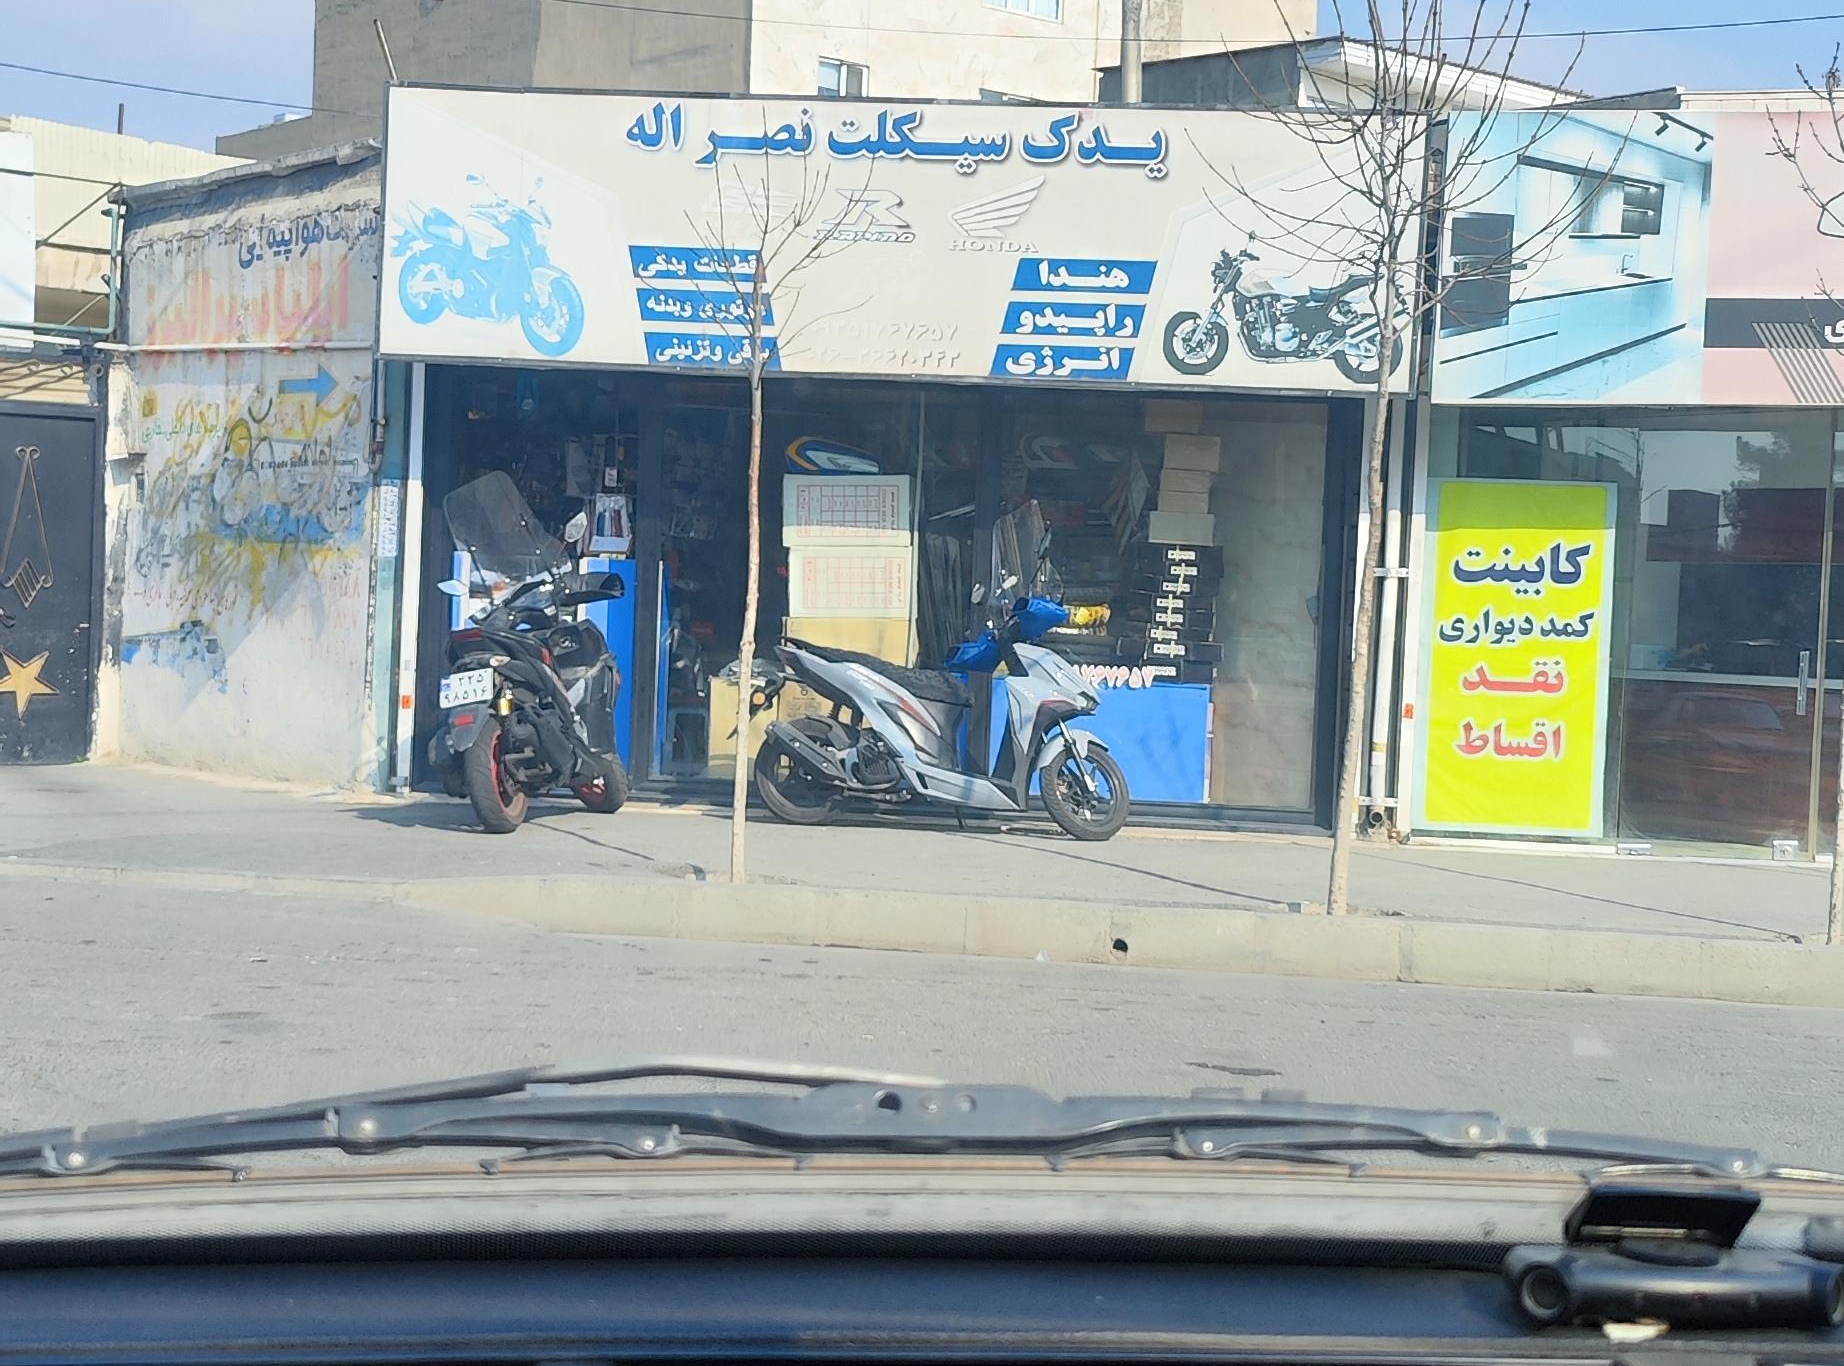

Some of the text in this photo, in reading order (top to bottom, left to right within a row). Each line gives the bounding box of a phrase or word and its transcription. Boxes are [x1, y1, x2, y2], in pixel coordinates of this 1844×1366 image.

[626, 102, 1168, 177] یدک سیکلت نصر اله
[949, 239, 1039, 253] HONDA
[638, 253, 687, 277] یدکی
[1038, 259, 1130, 288] هندا
[1016, 304, 1134, 337] راپیدو
[1005, 346, 1121, 376] انرژی
[1453, 542, 1591, 596] کابینت
[1439, 608, 1595, 644] کمد دیواری
[1462, 660, 1564, 694] نقد
[1456, 721, 1562, 758] اقساط
